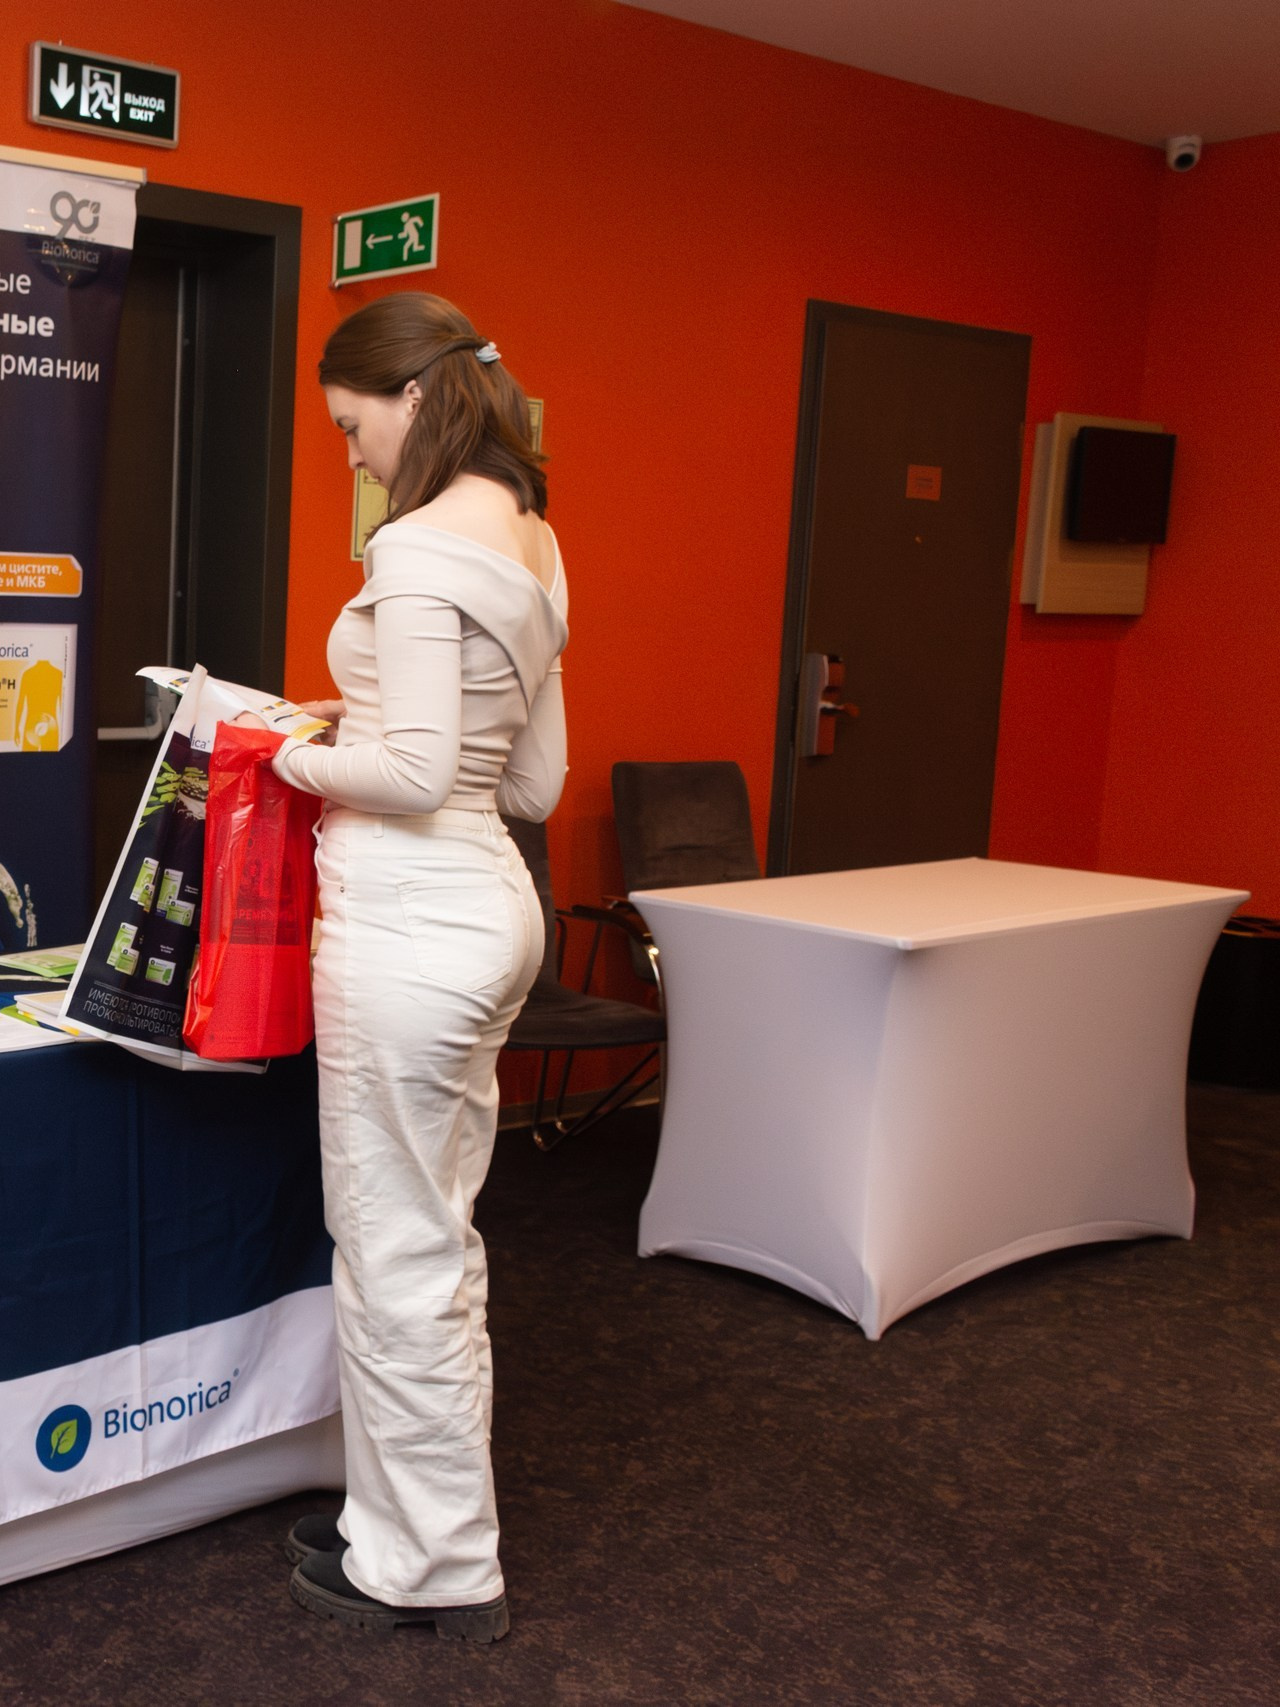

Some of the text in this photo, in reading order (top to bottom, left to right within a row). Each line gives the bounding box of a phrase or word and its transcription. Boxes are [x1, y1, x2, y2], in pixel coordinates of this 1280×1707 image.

[124, 92, 165, 112] ВЫХОД
[129, 107, 155, 123] EXIT
[9, 563, 63, 576] цистите,
[6, 578, 14, 586] и
[16, 575, 46, 588] МКБ
